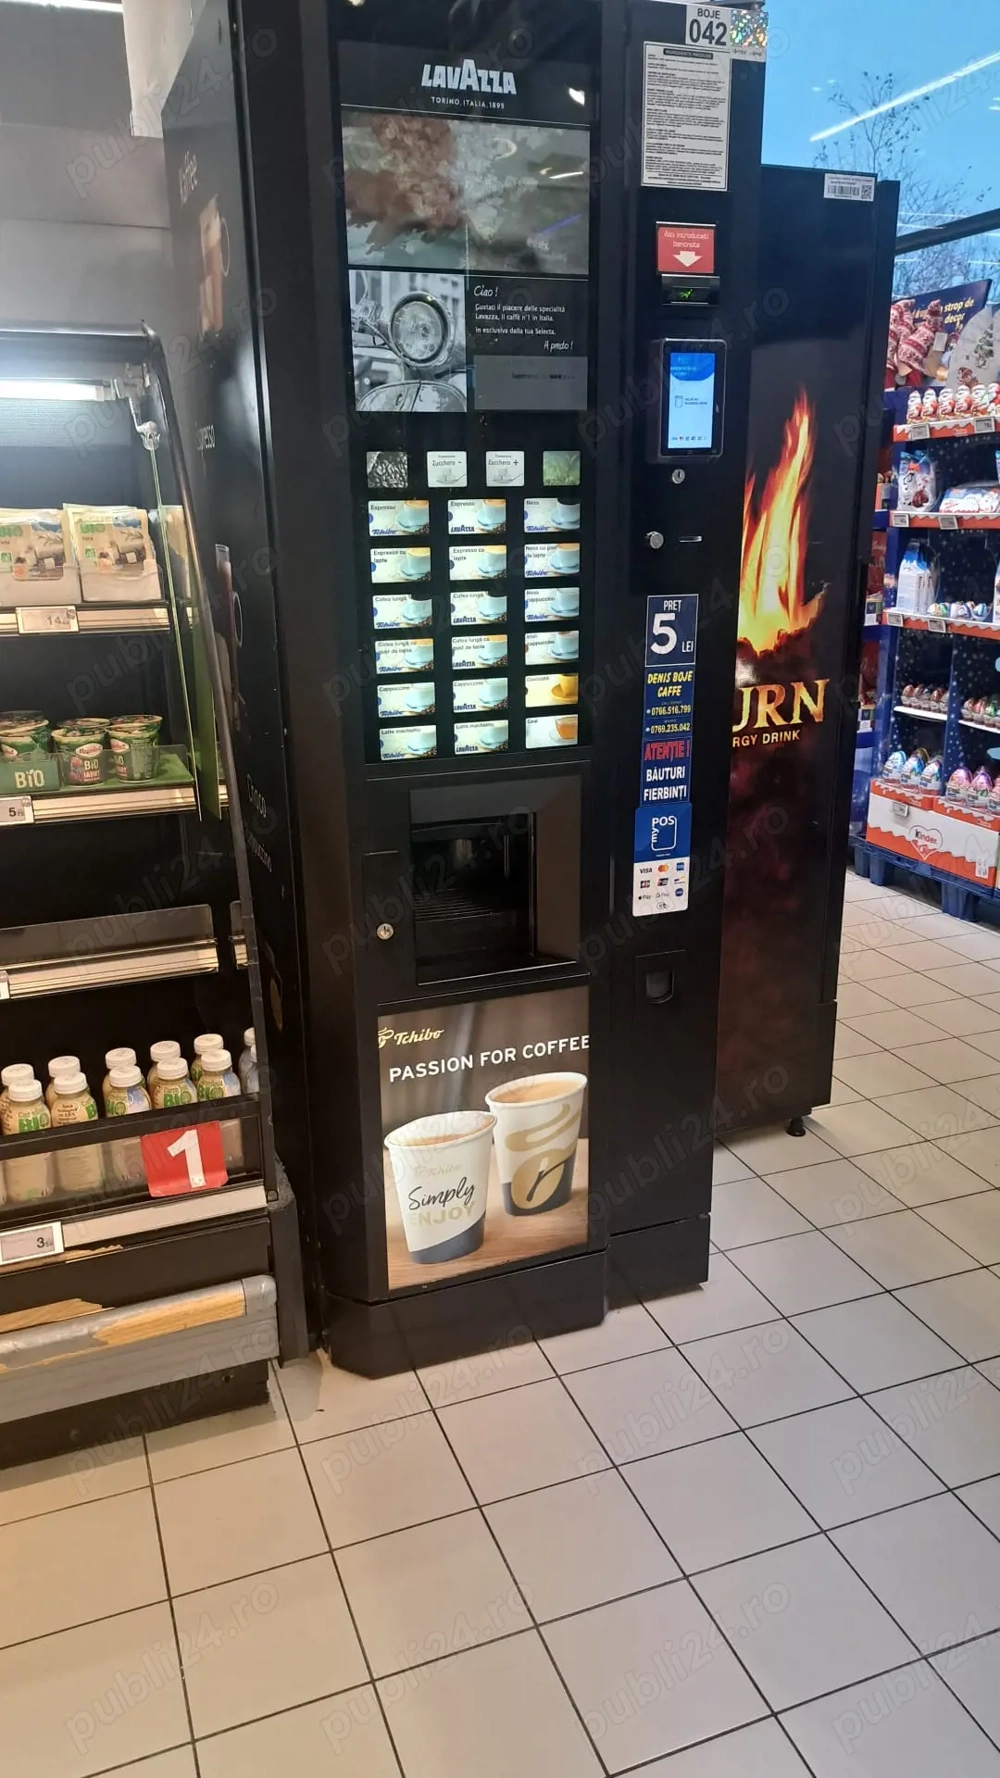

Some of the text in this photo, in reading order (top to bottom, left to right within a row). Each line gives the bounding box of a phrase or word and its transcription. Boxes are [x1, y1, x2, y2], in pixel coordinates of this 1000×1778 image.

[697, 8, 721, 20] BOJE
[689, 19, 728, 46] 042
[421, 59, 517, 94] LAVAZZA
[502, 305, 522, 313] piacere
[944, 297, 974, 313] strop de
[651, 613, 694, 655] 5 LEI
[647, 671, 693, 684] DENIS BOJE
[657, 685, 682, 697] CAFFE
[762, 730, 800, 744] DRINK
[394, 1028, 445, 1046] Tchibo
[389, 1035, 590, 1083] PASSION FOR COFFEE
[167, 1129, 206, 1188] 1
[408, 1176, 475, 1211] Simply
